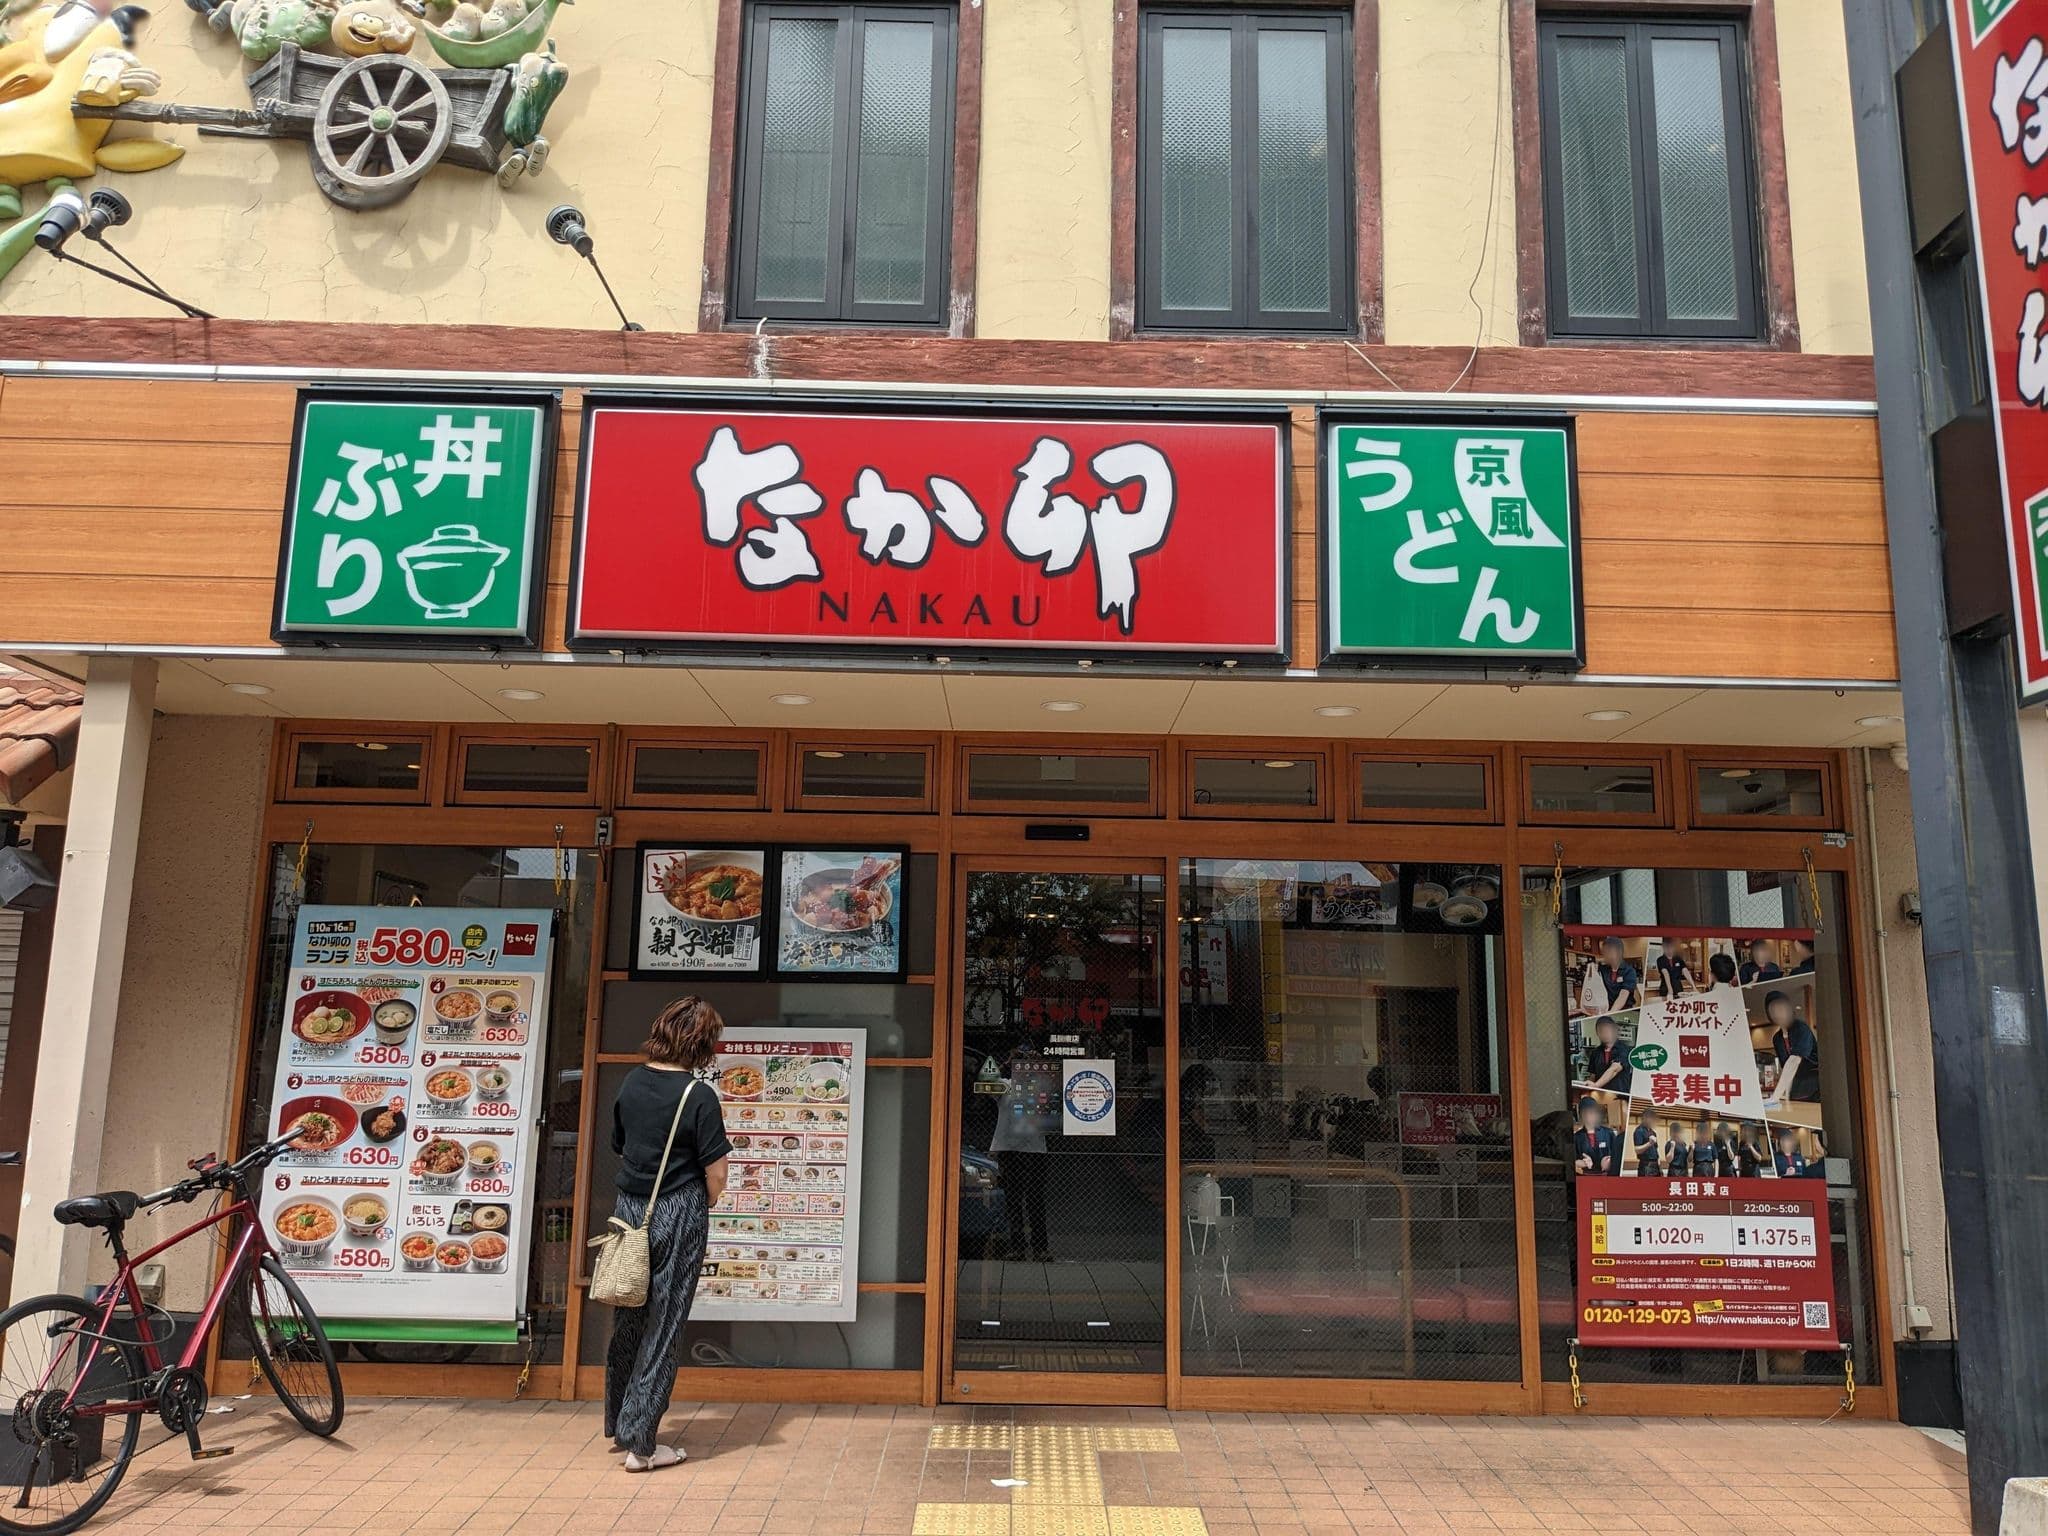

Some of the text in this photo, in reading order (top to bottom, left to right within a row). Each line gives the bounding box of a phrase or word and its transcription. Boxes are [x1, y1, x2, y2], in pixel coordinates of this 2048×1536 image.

[1465, 444, 1534, 540] 京風
[693, 425, 1177, 634] なか卯
[1346, 437, 1540, 643] うどん
[819, 592, 1042, 627] NAKAU
[309, 936, 351, 947] なか卯の
[648, 926, 734, 958] 親子丼
[306, 950, 350, 963] ランチ
[1666, 1001, 1719, 1014] なか卯で
[1663, 1016, 1722, 1029] アルバイト
[724, 1044, 808, 1054] お持ち帰りメニュー
[1681, 1045, 1708, 1057] なか卯
[1651, 1073, 1741, 1105] 募集中
[412, 1204, 441, 1215] 他にも
[406, 1216, 445, 1227] いろいろ
[1584, 1308, 1692, 1324] 0120-129-073
[1696, 1314, 1800, 1328] http://www.nakau.co.jp/
